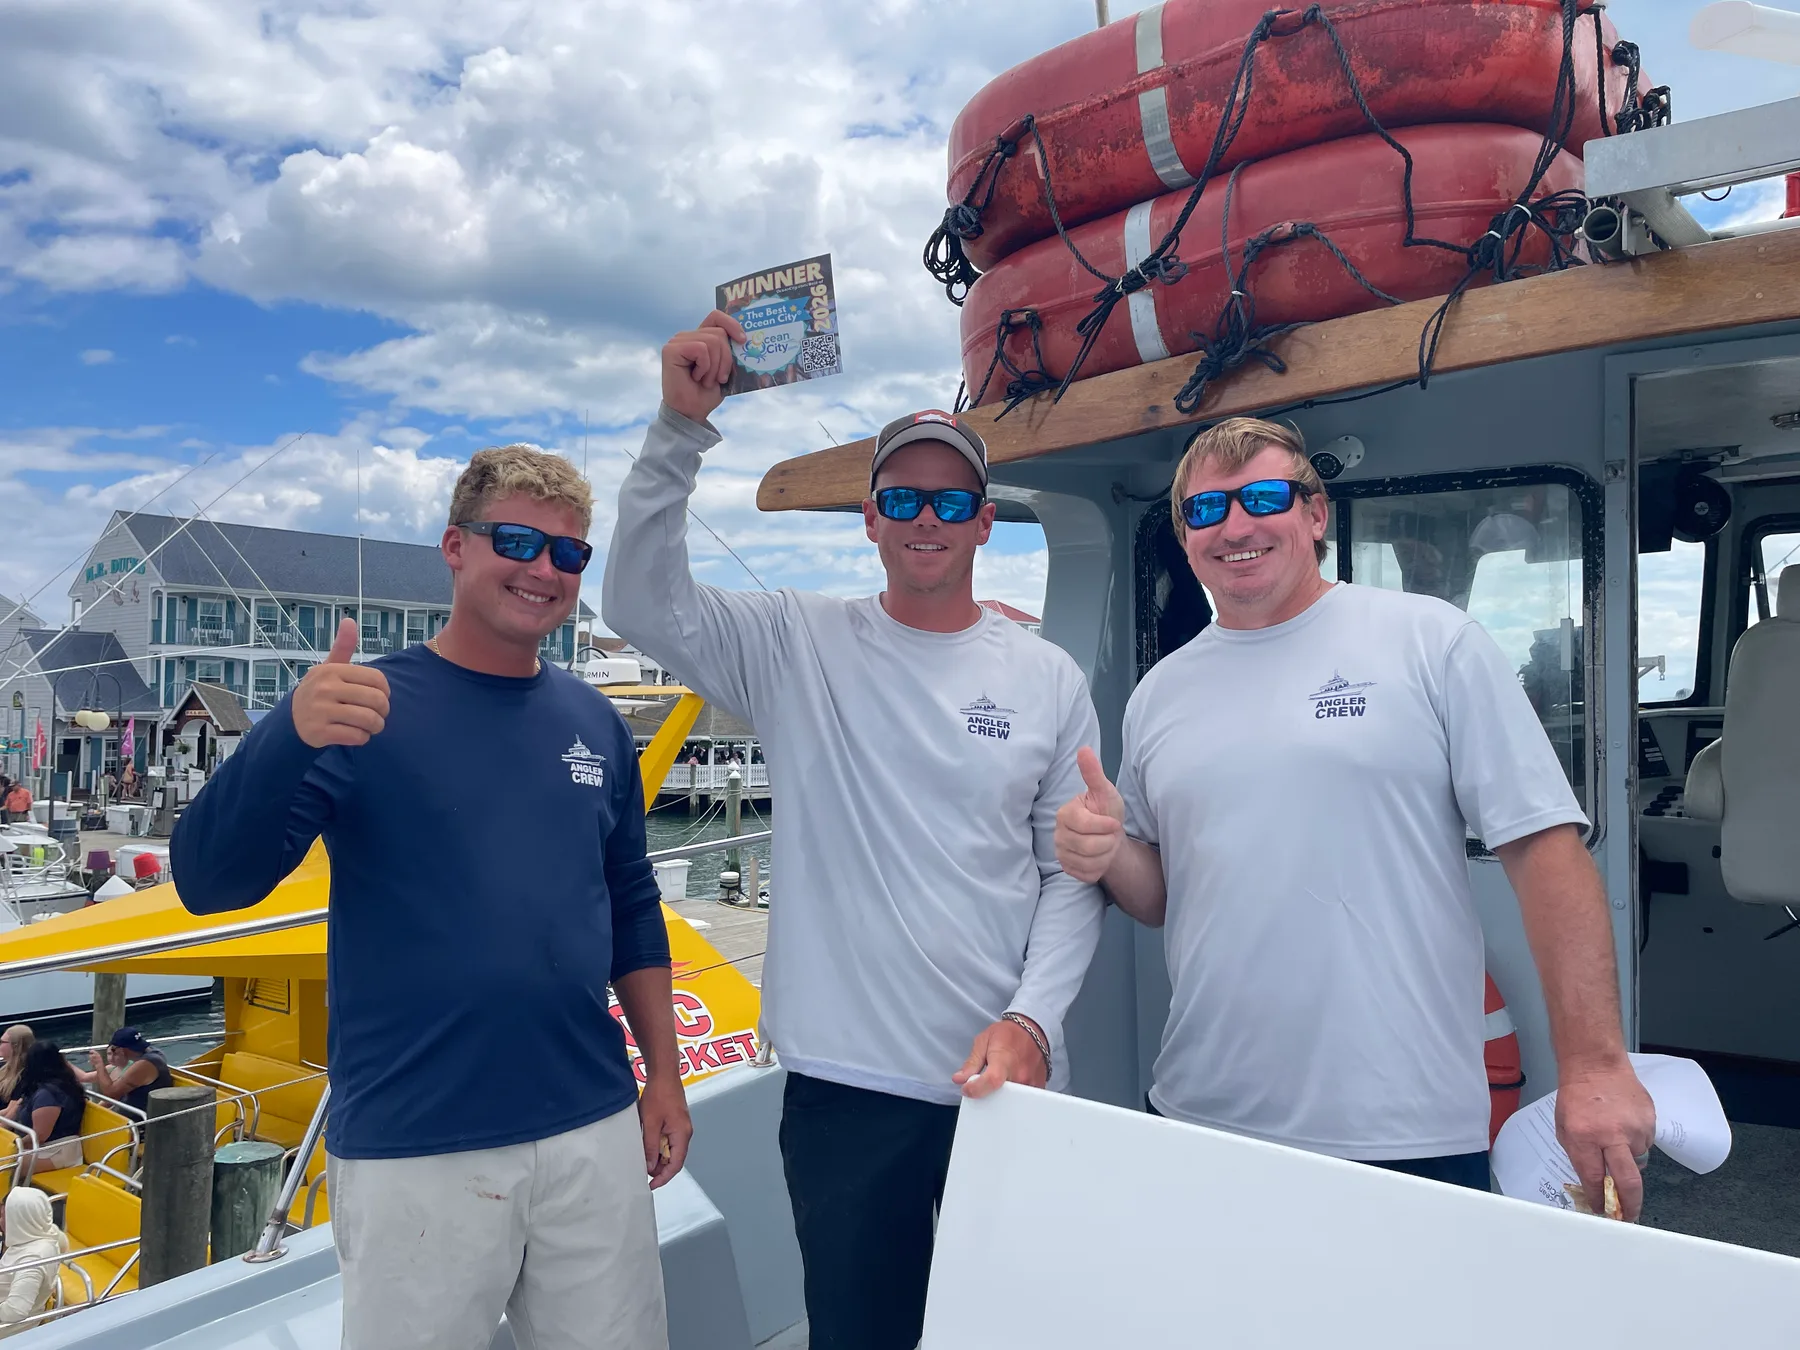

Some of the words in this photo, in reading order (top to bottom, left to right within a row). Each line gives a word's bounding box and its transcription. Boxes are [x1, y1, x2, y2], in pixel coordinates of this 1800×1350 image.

[724, 262, 824, 301] WINNER
[746, 310, 764, 320] The
[766, 305, 787, 316] Best
[811, 284, 831, 333] 2026
[744, 318, 776, 329] Ocean
[766, 342, 788, 354] City
[1315, 696, 1367, 708] ANGLER
[1315, 705, 1366, 719] CREW
[967, 716, 1011, 729] ANGLER
[967, 724, 1010, 740] CREW
[570, 762, 604, 777] ANGLER
[571, 772, 604, 788] CREW
